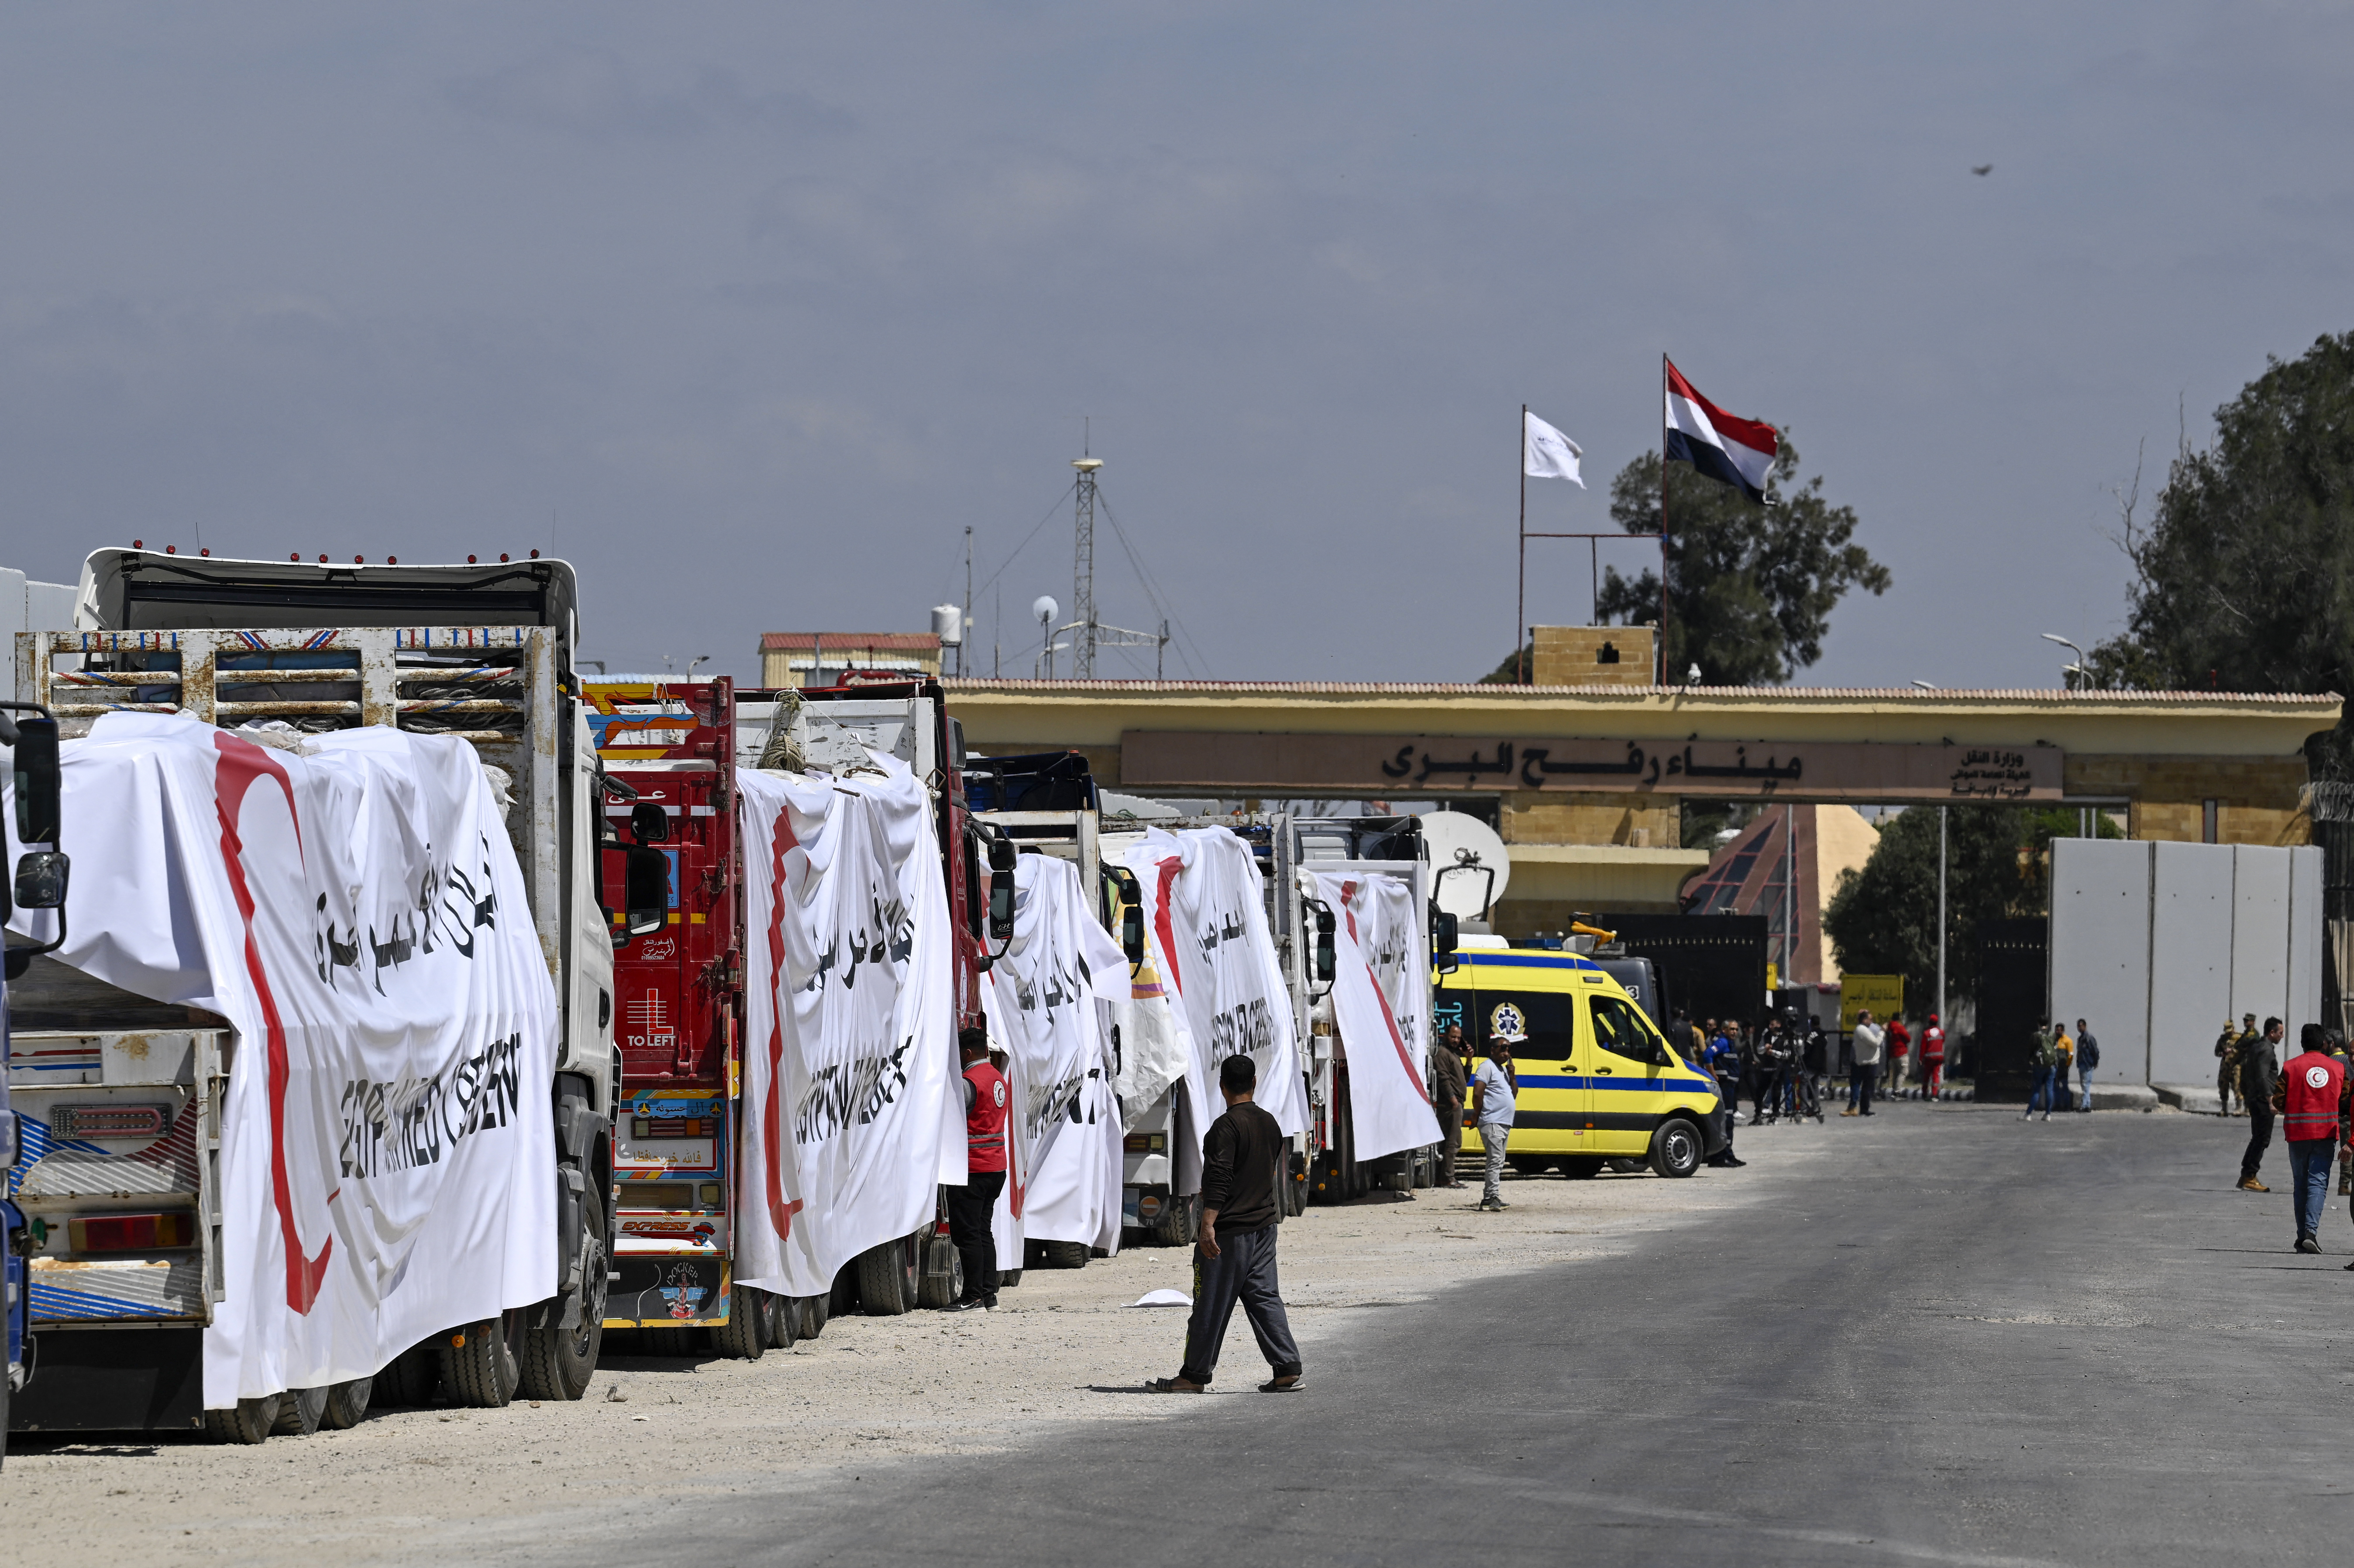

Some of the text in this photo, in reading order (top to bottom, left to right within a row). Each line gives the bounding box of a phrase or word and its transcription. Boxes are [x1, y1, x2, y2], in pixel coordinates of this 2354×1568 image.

[1522, 741, 1660, 786] رفح
[1667, 746, 1802, 788] ميناء
[627, 1035, 676, 1046] TO LEFT
[661, 1152, 678, 1166] خير
[682, 1149, 701, 1163] فالله
[622, 1221, 691, 1231] EXPRESS
